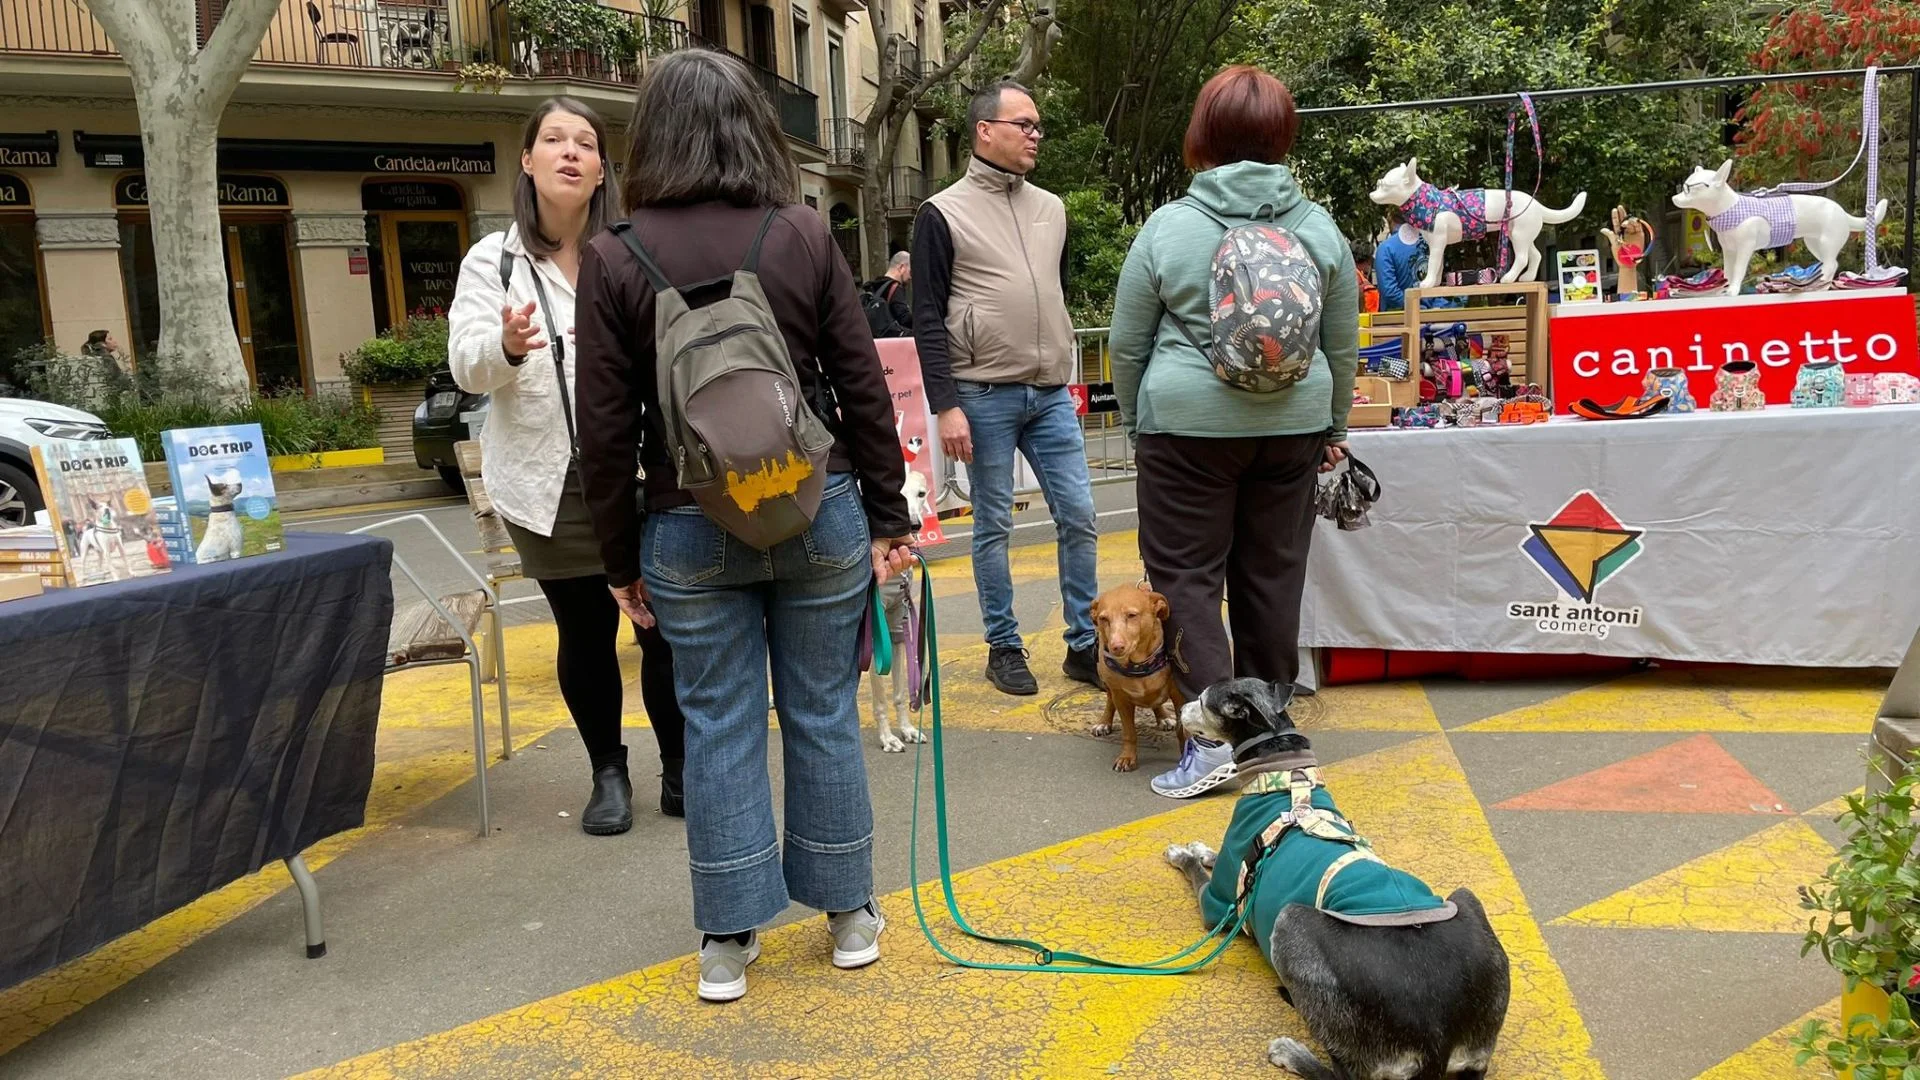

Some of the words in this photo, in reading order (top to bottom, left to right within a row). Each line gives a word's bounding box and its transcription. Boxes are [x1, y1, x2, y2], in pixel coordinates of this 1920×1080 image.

[374, 155, 436, 172] Candela
[437, 161, 450, 171] en
[451, 157, 492, 173] Rama
[225, 183, 279, 202] Rama
[410, 261, 456, 274] VERMUT
[1572, 329, 1898, 378] caninetto
[898, 390, 912, 401] pet
[188, 444, 219, 458] DOG
[219, 440, 253, 454] TRIP
[60, 458, 93, 472] DOG
[93, 455, 129, 469] TRIP
[1509, 604, 1561, 619] sant
[1566, 606, 1640, 625] antoni
[1538, 619, 1607, 638] comerç
